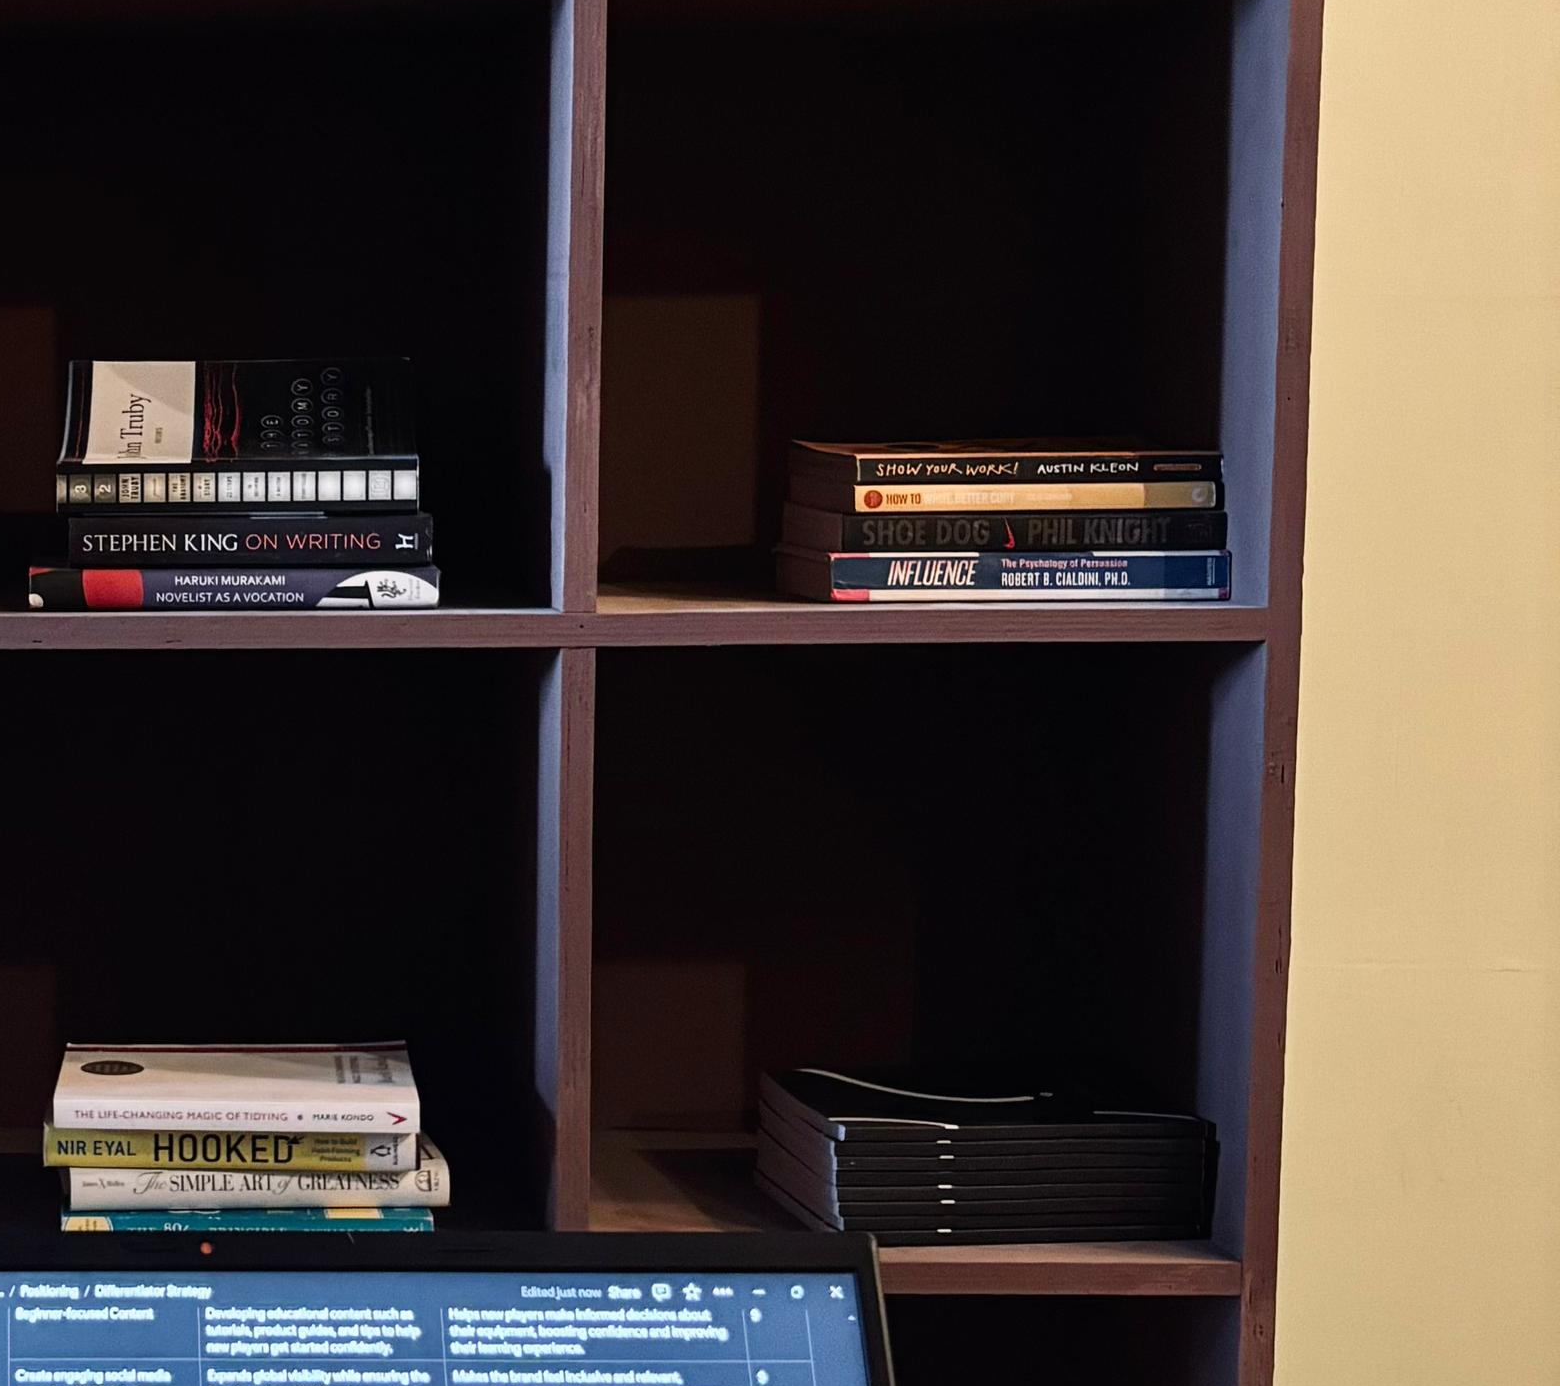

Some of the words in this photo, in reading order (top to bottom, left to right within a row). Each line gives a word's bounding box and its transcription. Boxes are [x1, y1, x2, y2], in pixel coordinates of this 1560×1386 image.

[877, 463, 922, 476] SHOW
[926, 463, 963, 475] YOUR
[966, 463, 1018, 476] WORK!
[1037, 463, 1084, 474] AUSTIN
[1090, 462, 1138, 473] KLEON
[82, 534, 176, 551] STEPHEN
[185, 534, 238, 550] KING
[246, 533, 277, 549] ON
[287, 533, 380, 549] WRITING
[175, 575, 218, 586] HARUKI
[221, 575, 285, 586] MURAKAMI
[888, 561, 978, 586] INFLUENCE
[1001, 573, 1040, 586] ROBERT
[1043, 572, 1052, 586] B.
[1055, 572, 1102, 587] CIALDINI,
[1105, 572, 1130, 585] PH.D.
[156, 593, 212, 602] NOVELIST
[215, 593, 229, 602] AS
[232, 593, 240, 602] A
[243, 592, 304, 602] VOCATION
[57, 1141, 86, 1155] NIR
[93, 1141, 136, 1156] EYAL
[154, 1132, 293, 1164] HOOKED
